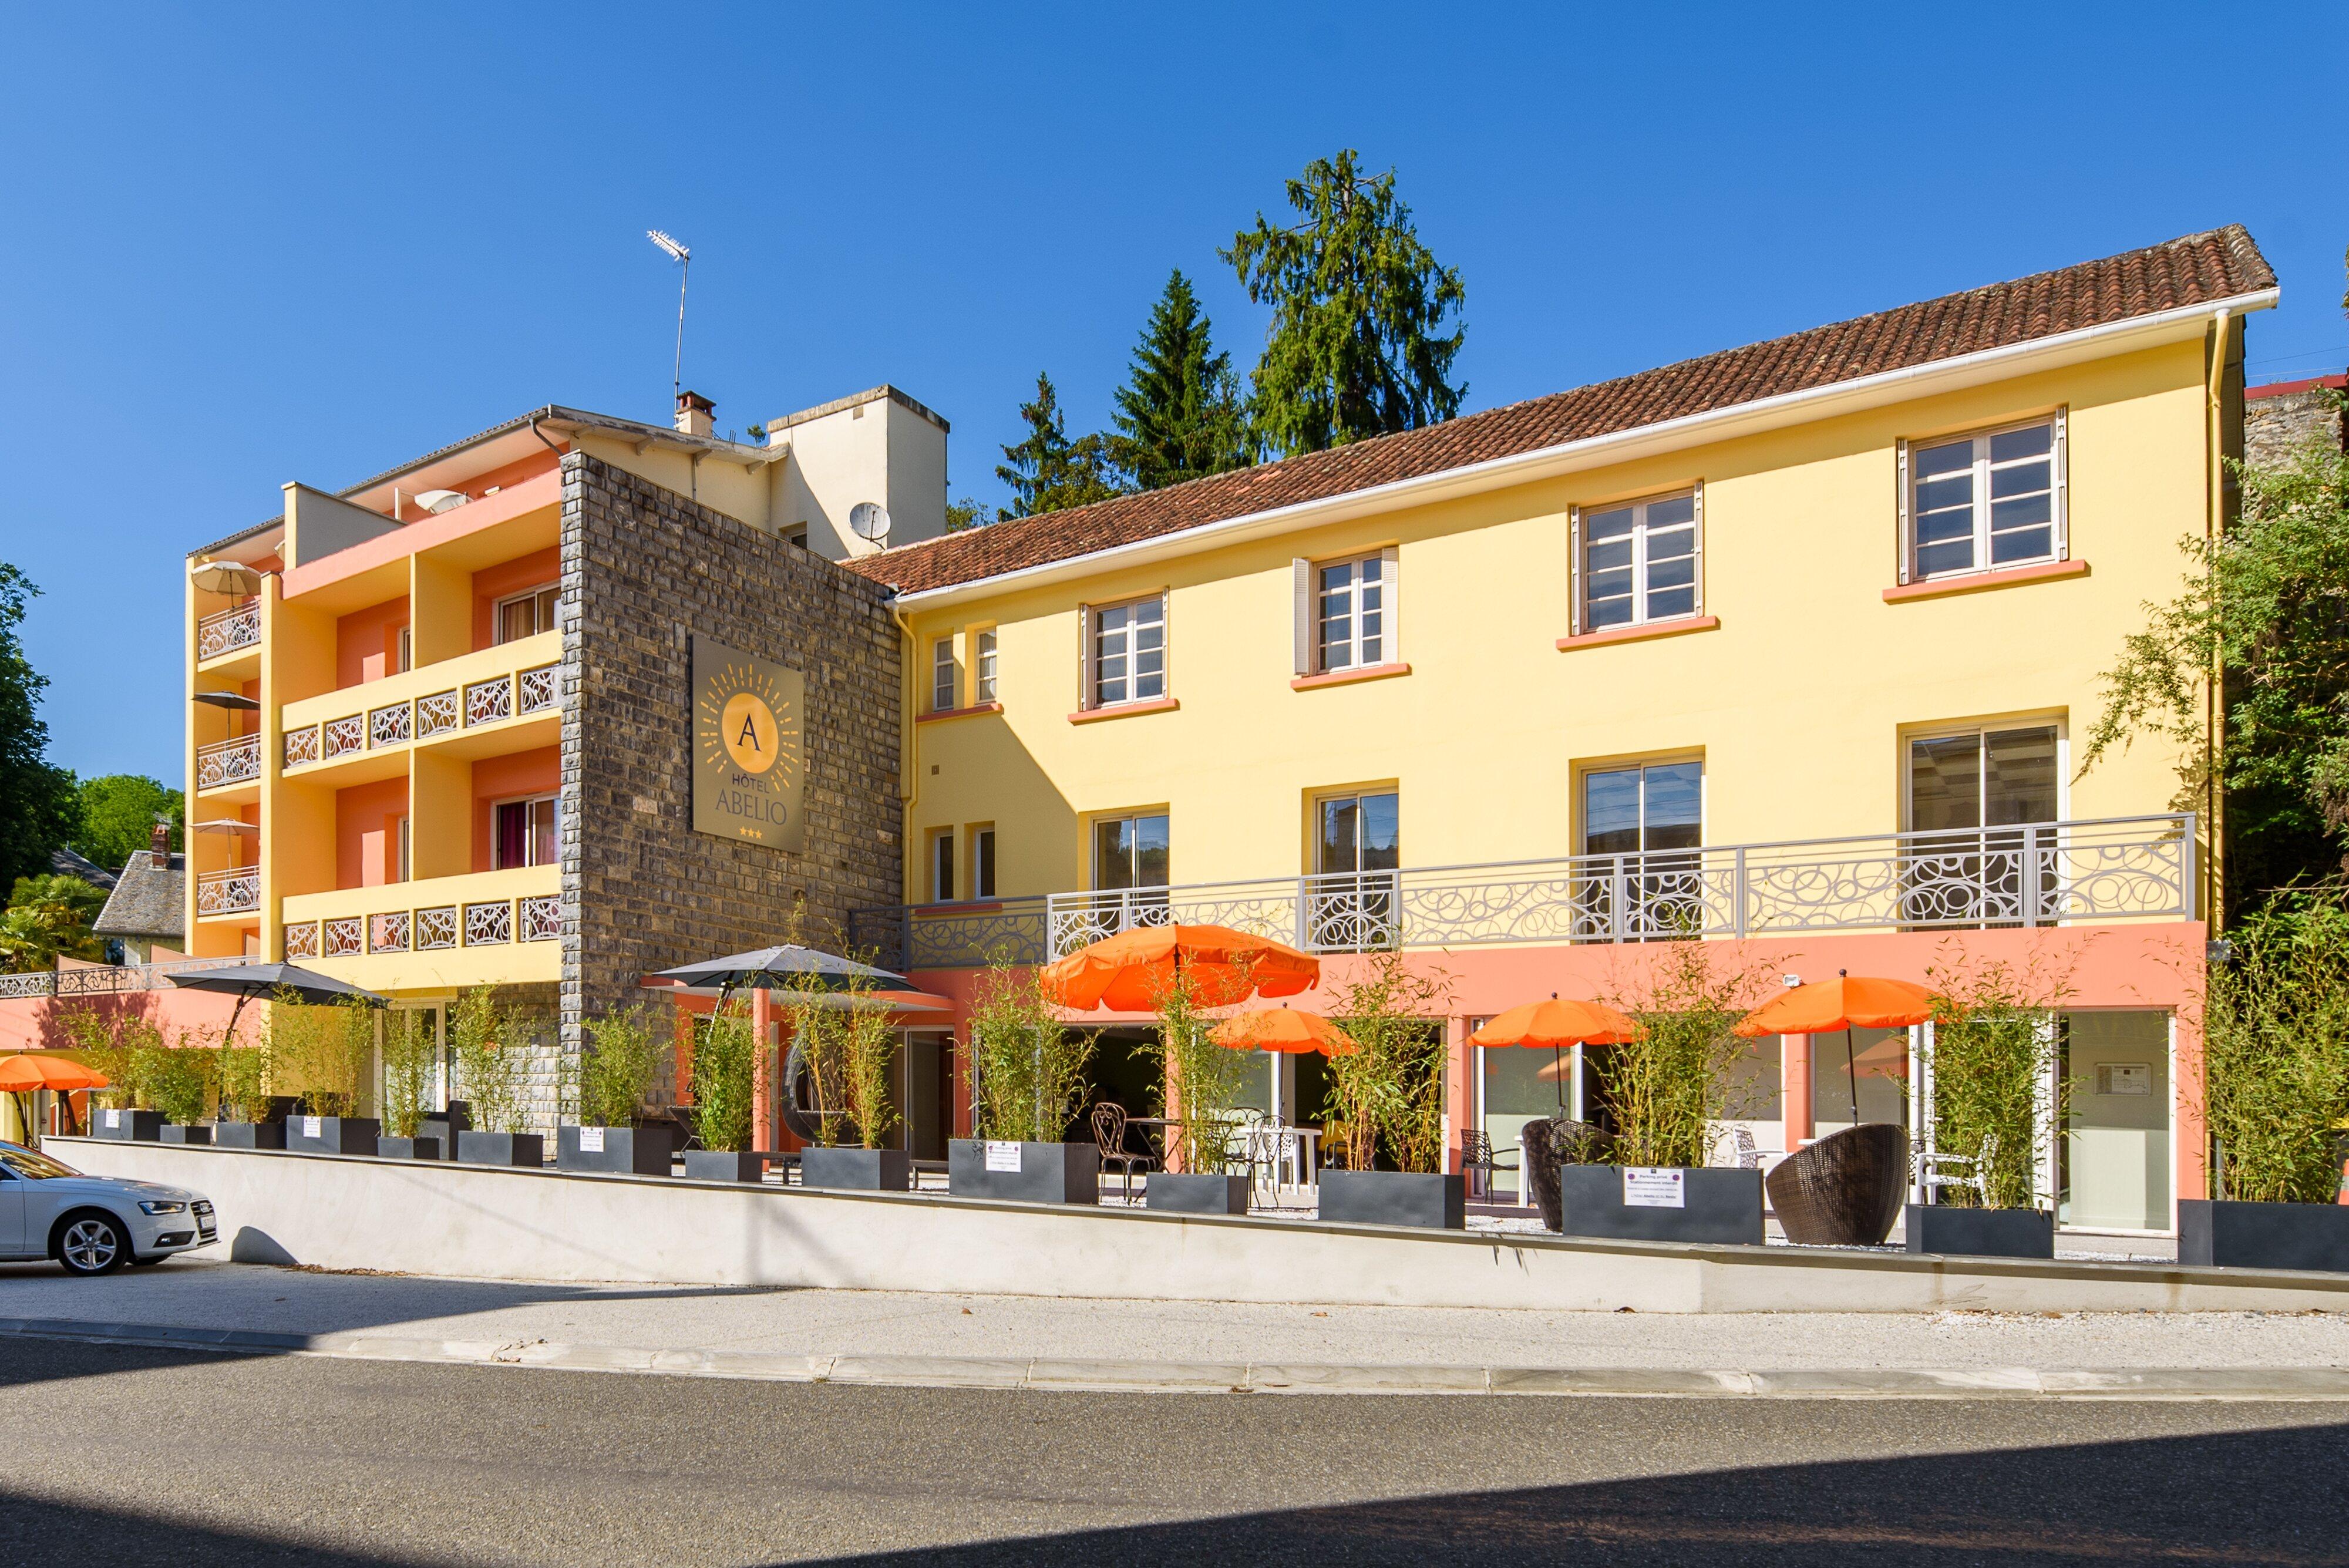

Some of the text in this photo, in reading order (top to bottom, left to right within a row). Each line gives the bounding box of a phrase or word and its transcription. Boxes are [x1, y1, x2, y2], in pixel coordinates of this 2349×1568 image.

[737, 712, 762, 752] A
[732, 773, 770, 793] HÔTEL
[715, 788, 787, 825] ABELIO
